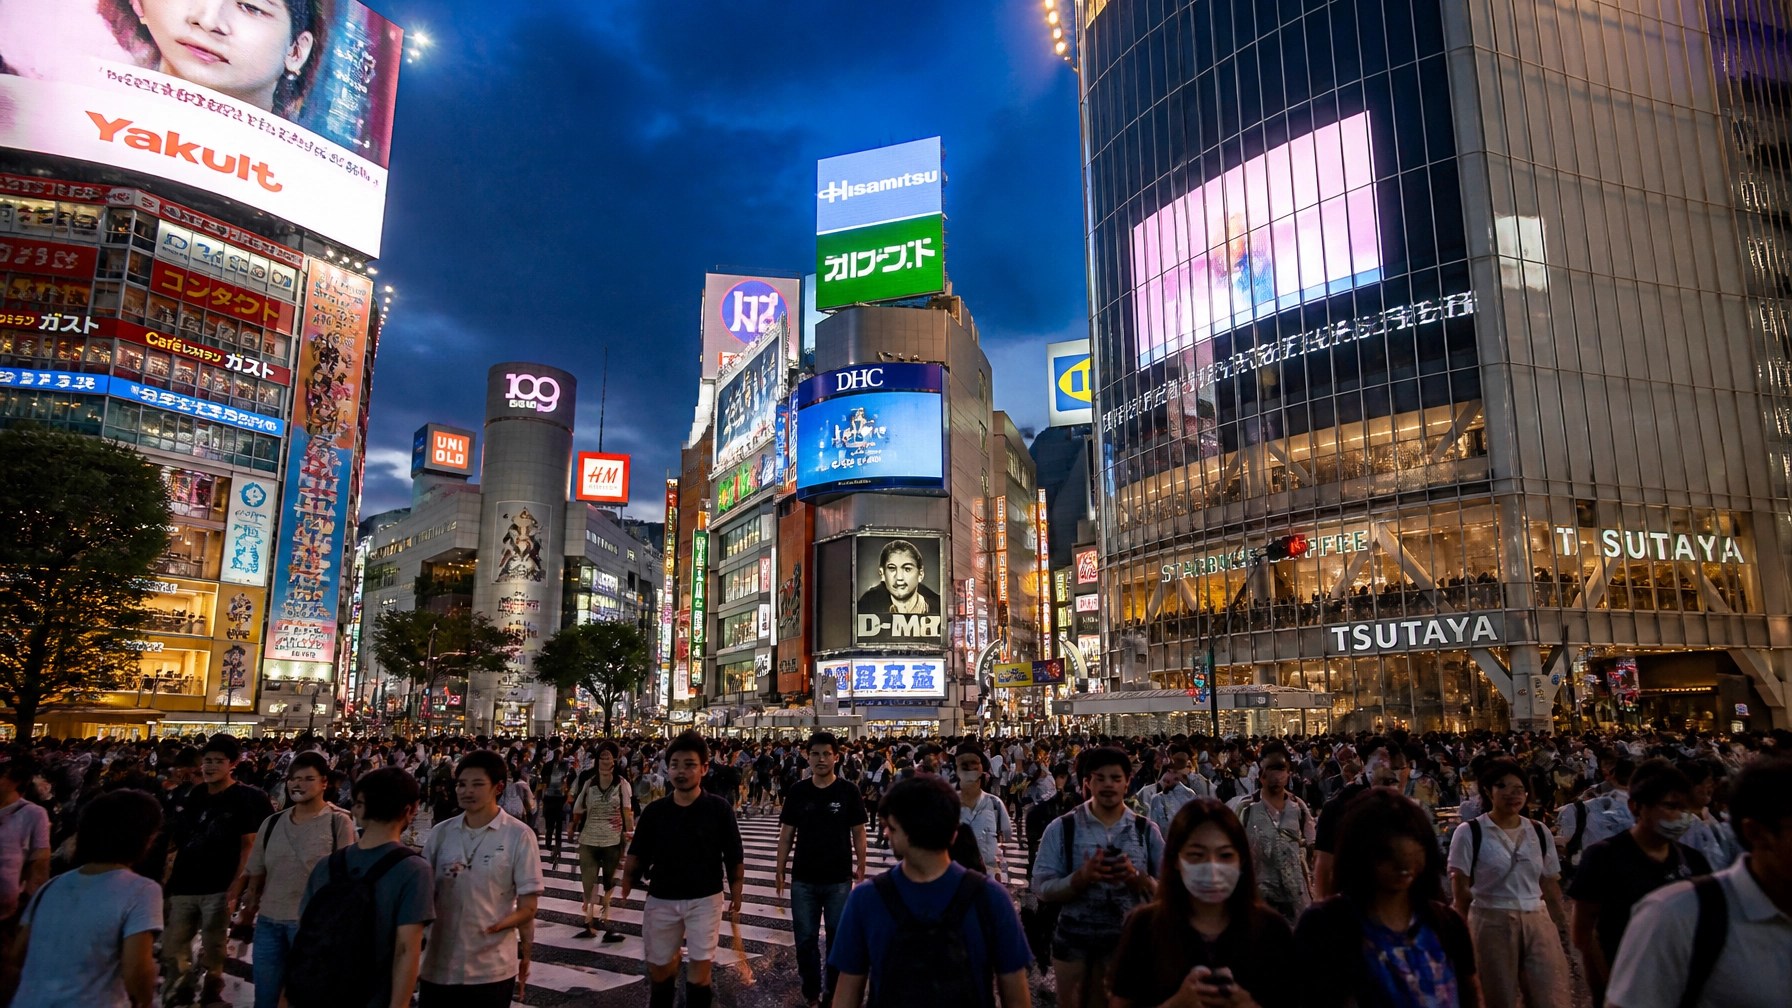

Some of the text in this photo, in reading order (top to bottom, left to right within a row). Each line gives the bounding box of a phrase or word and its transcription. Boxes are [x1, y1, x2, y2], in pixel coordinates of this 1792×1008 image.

[86, 110, 283, 193] Yakult
[817, 170, 938, 203] Hisamitsu
[38, 313, 99, 334] ガスト
[225, 353, 274, 379] ガスト
[836, 368, 883, 391] DHC
[505, 373, 560, 412] 109
[437, 436, 463, 452] UNI
[1331, 615, 1498, 651] TSUTAYA
